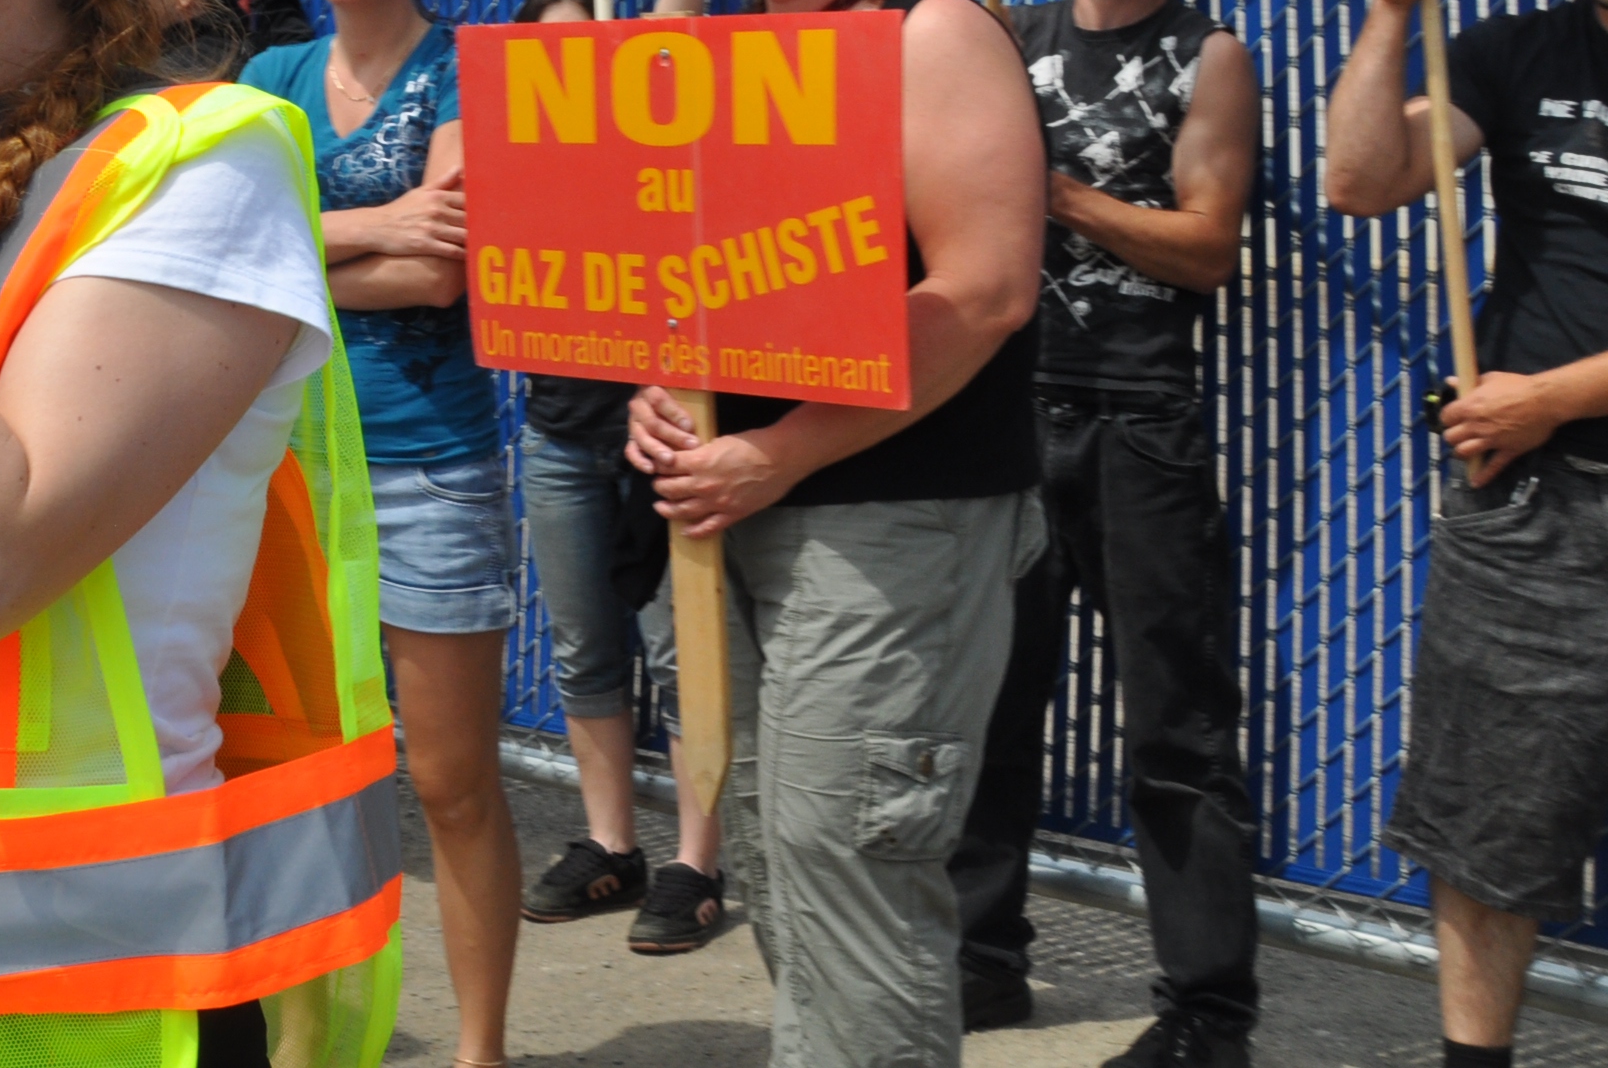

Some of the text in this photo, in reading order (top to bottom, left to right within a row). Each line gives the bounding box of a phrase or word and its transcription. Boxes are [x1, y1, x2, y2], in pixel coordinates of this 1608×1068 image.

[504, 28, 838, 147] NON
[636, 167, 696, 213] au
[477, 195, 889, 320] GAZ DE SCHISTE
[481, 320, 892, 393] Un moratoire dès maintenant
